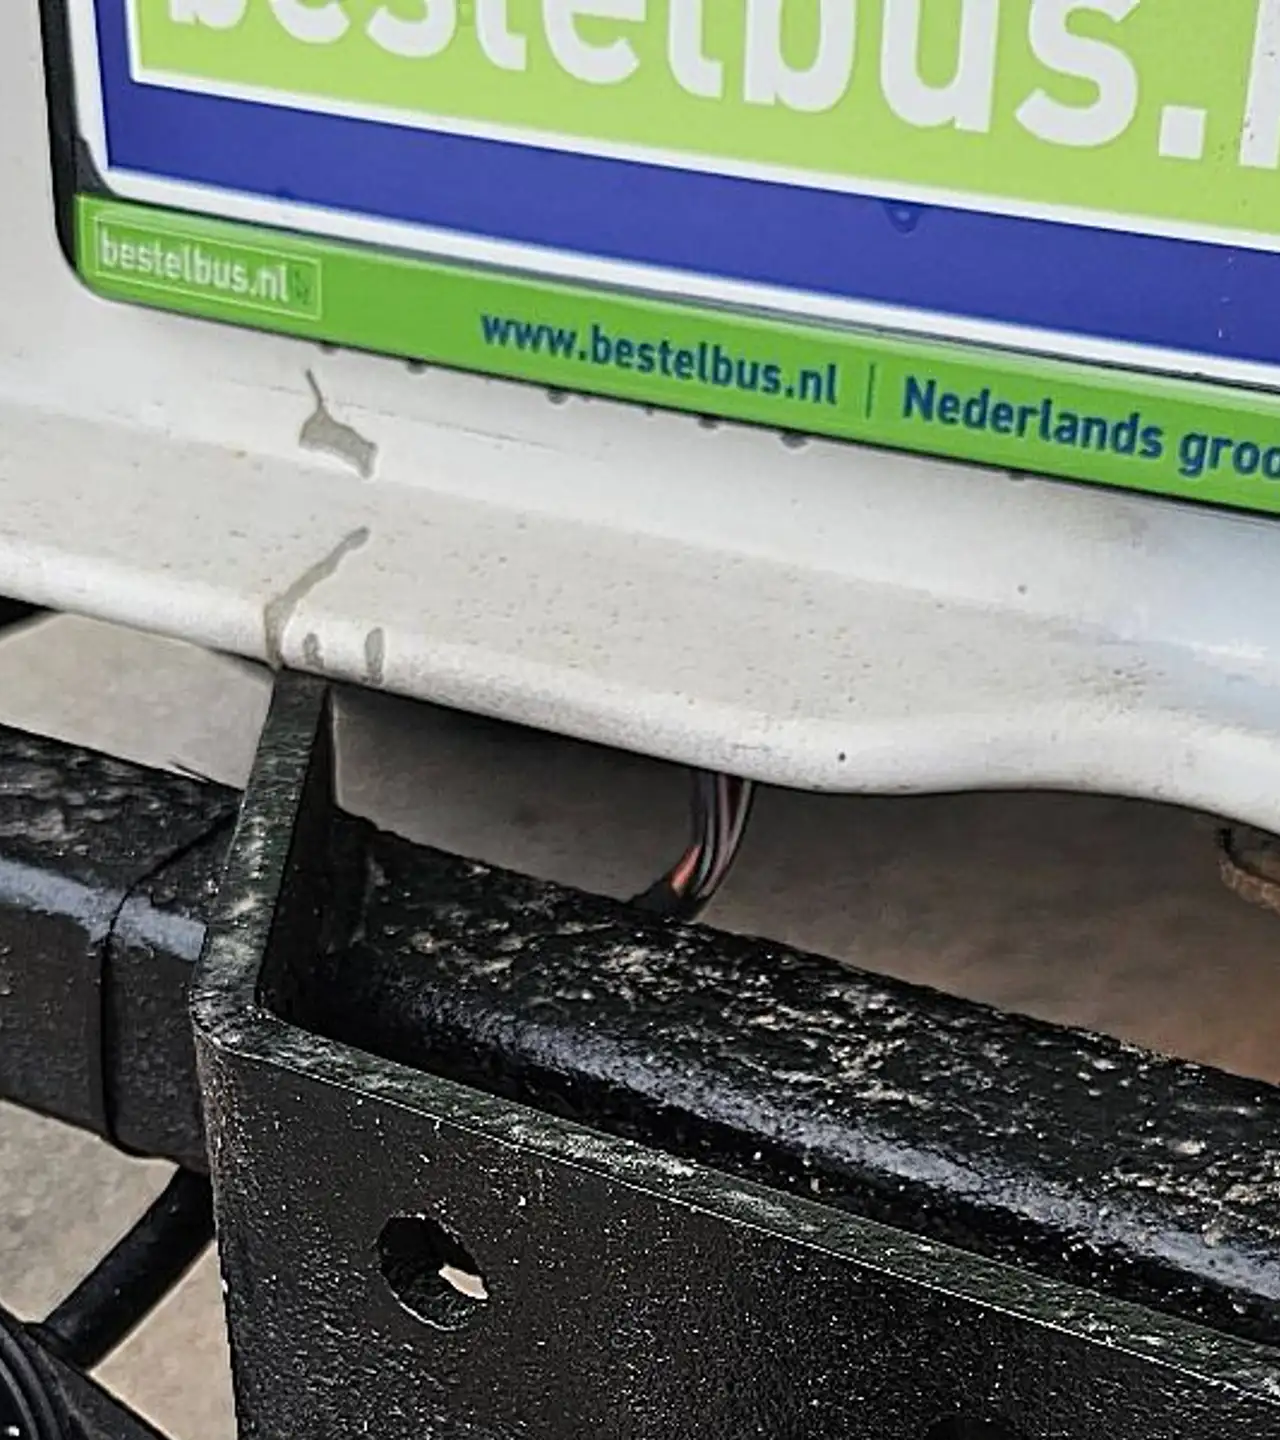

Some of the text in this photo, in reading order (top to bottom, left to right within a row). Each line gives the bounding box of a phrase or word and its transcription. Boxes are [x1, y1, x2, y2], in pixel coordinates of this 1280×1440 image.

[99, 227, 288, 303] bestelbus.nl
[480, 312, 838, 406] www.bestelbus.nl
[903, 375, 1163, 459] Nederlands
